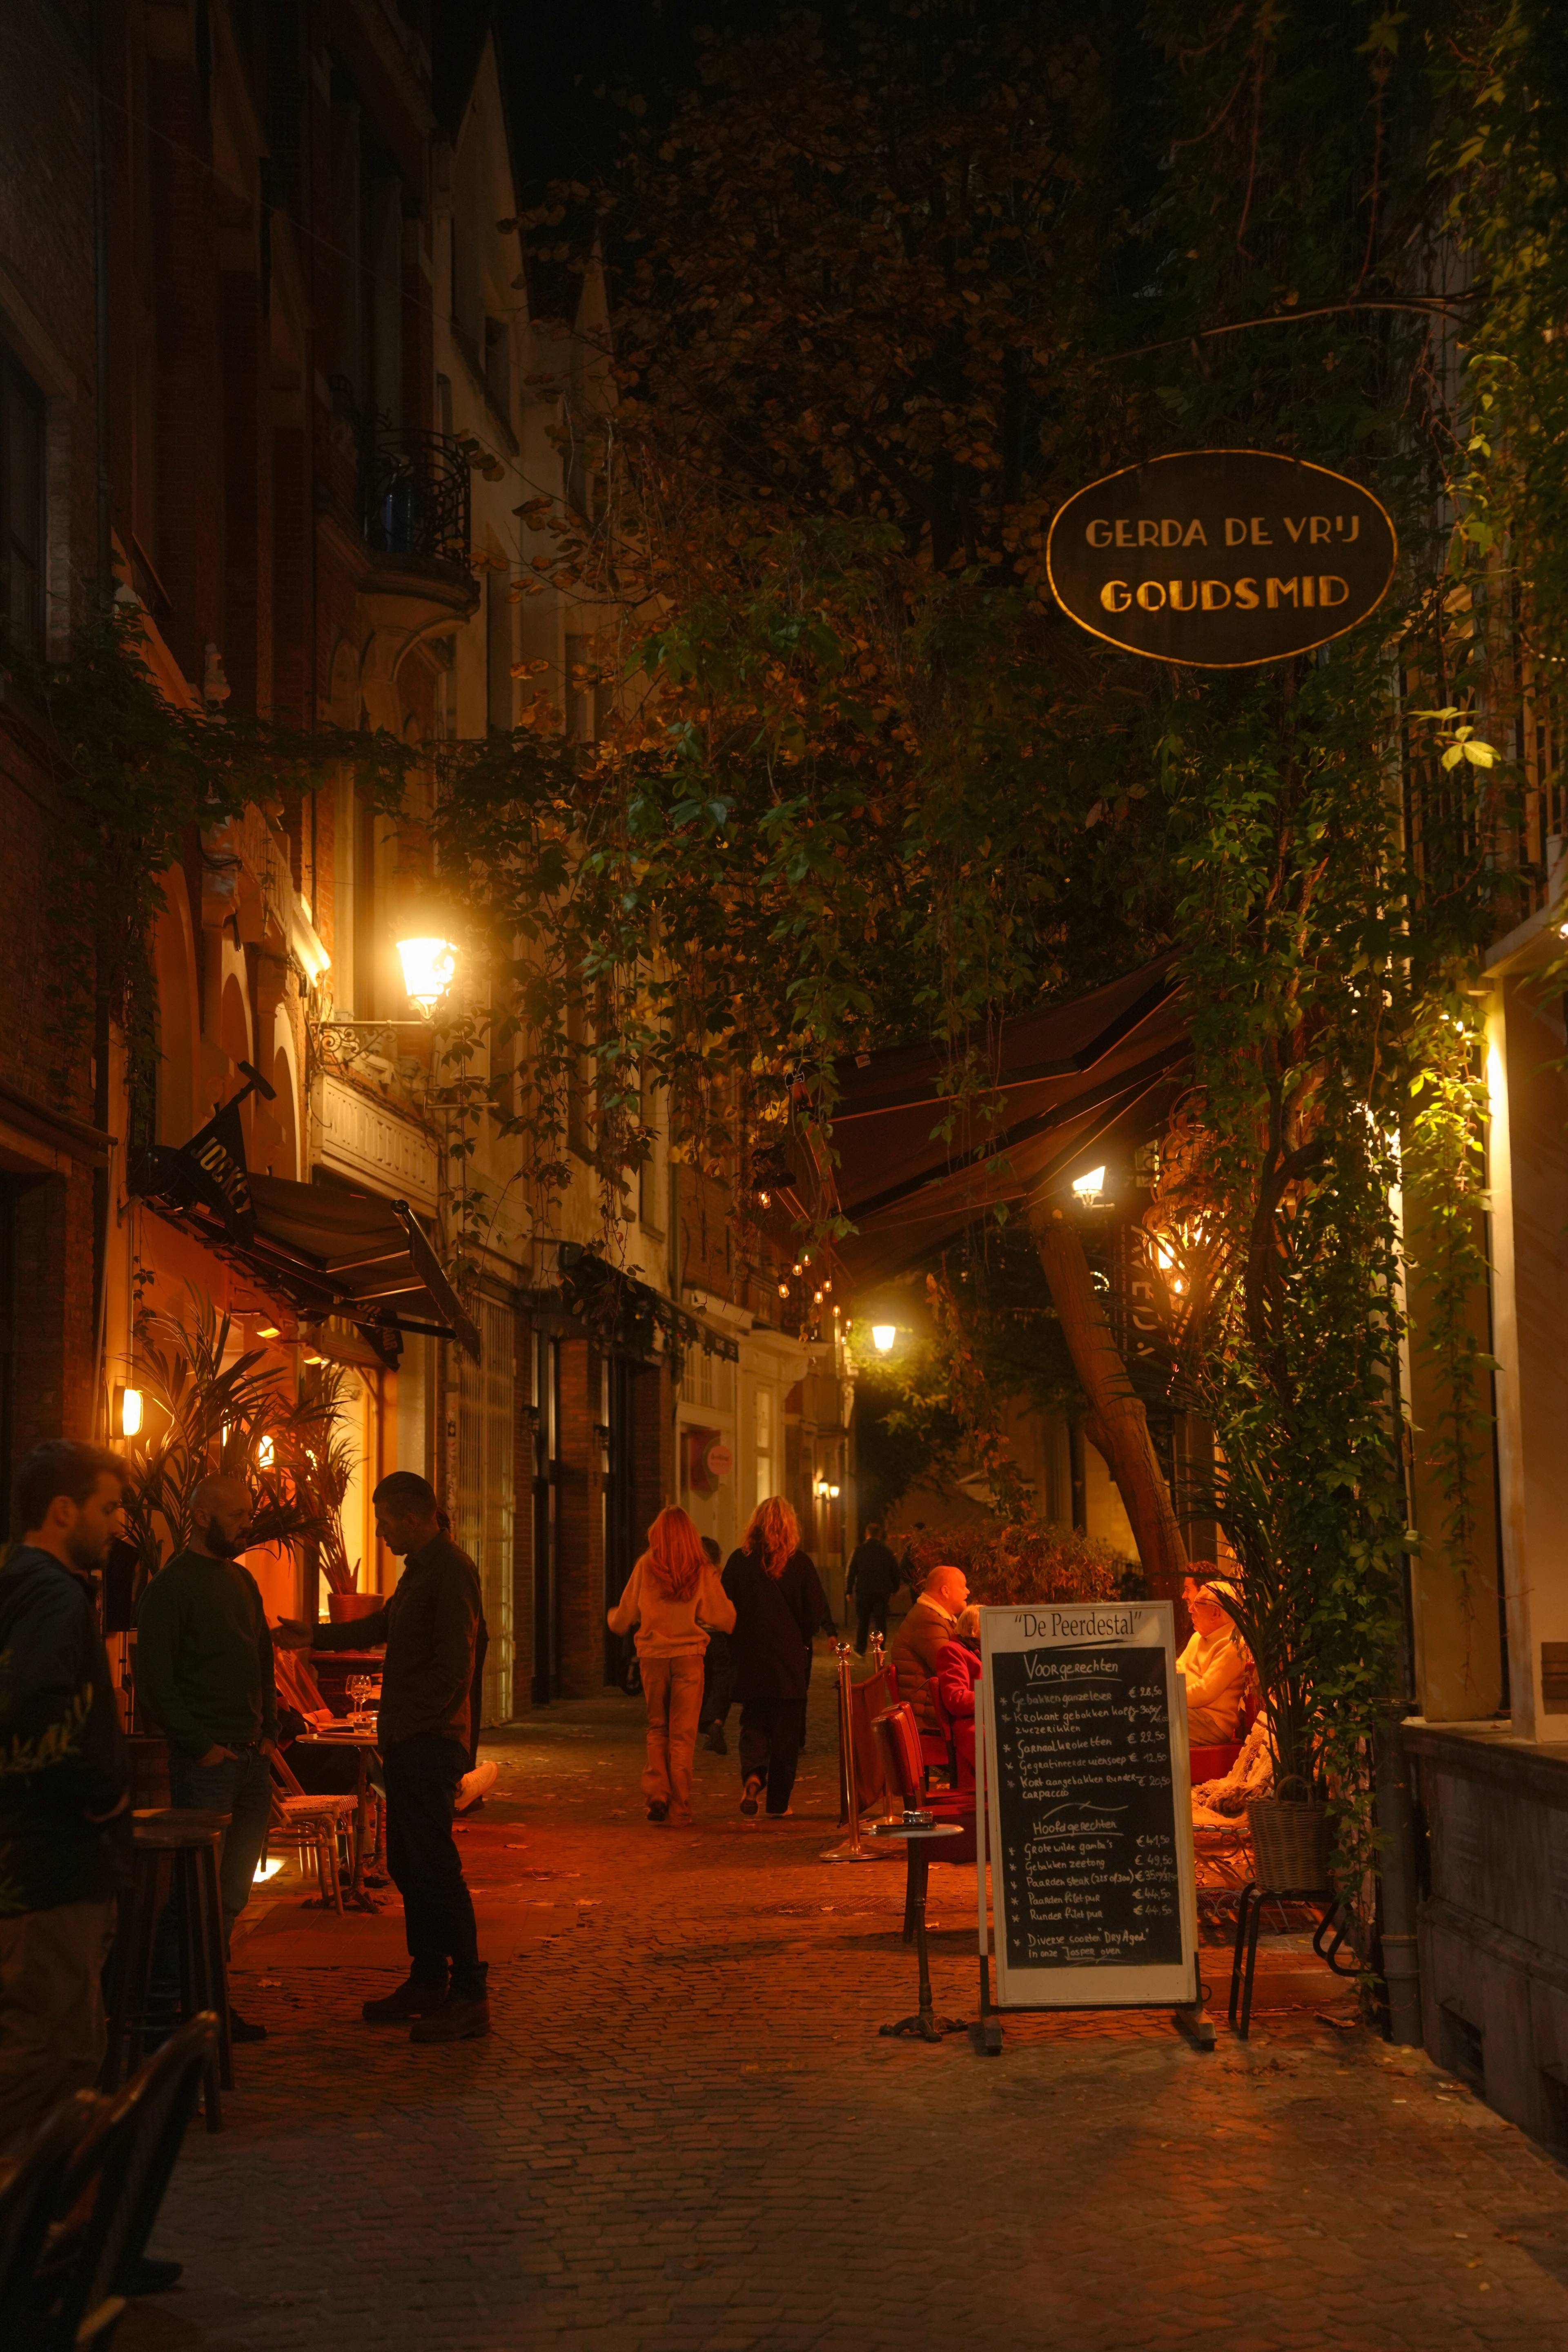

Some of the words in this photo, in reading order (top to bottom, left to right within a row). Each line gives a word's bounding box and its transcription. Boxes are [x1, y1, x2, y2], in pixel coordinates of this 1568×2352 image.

[1085, 519, 1208, 548] GERDA
[1225, 517, 1273, 546] DE
[1100, 575, 1350, 612] GOUDSMID
[190, 1136, 251, 1214] JOCKEY
